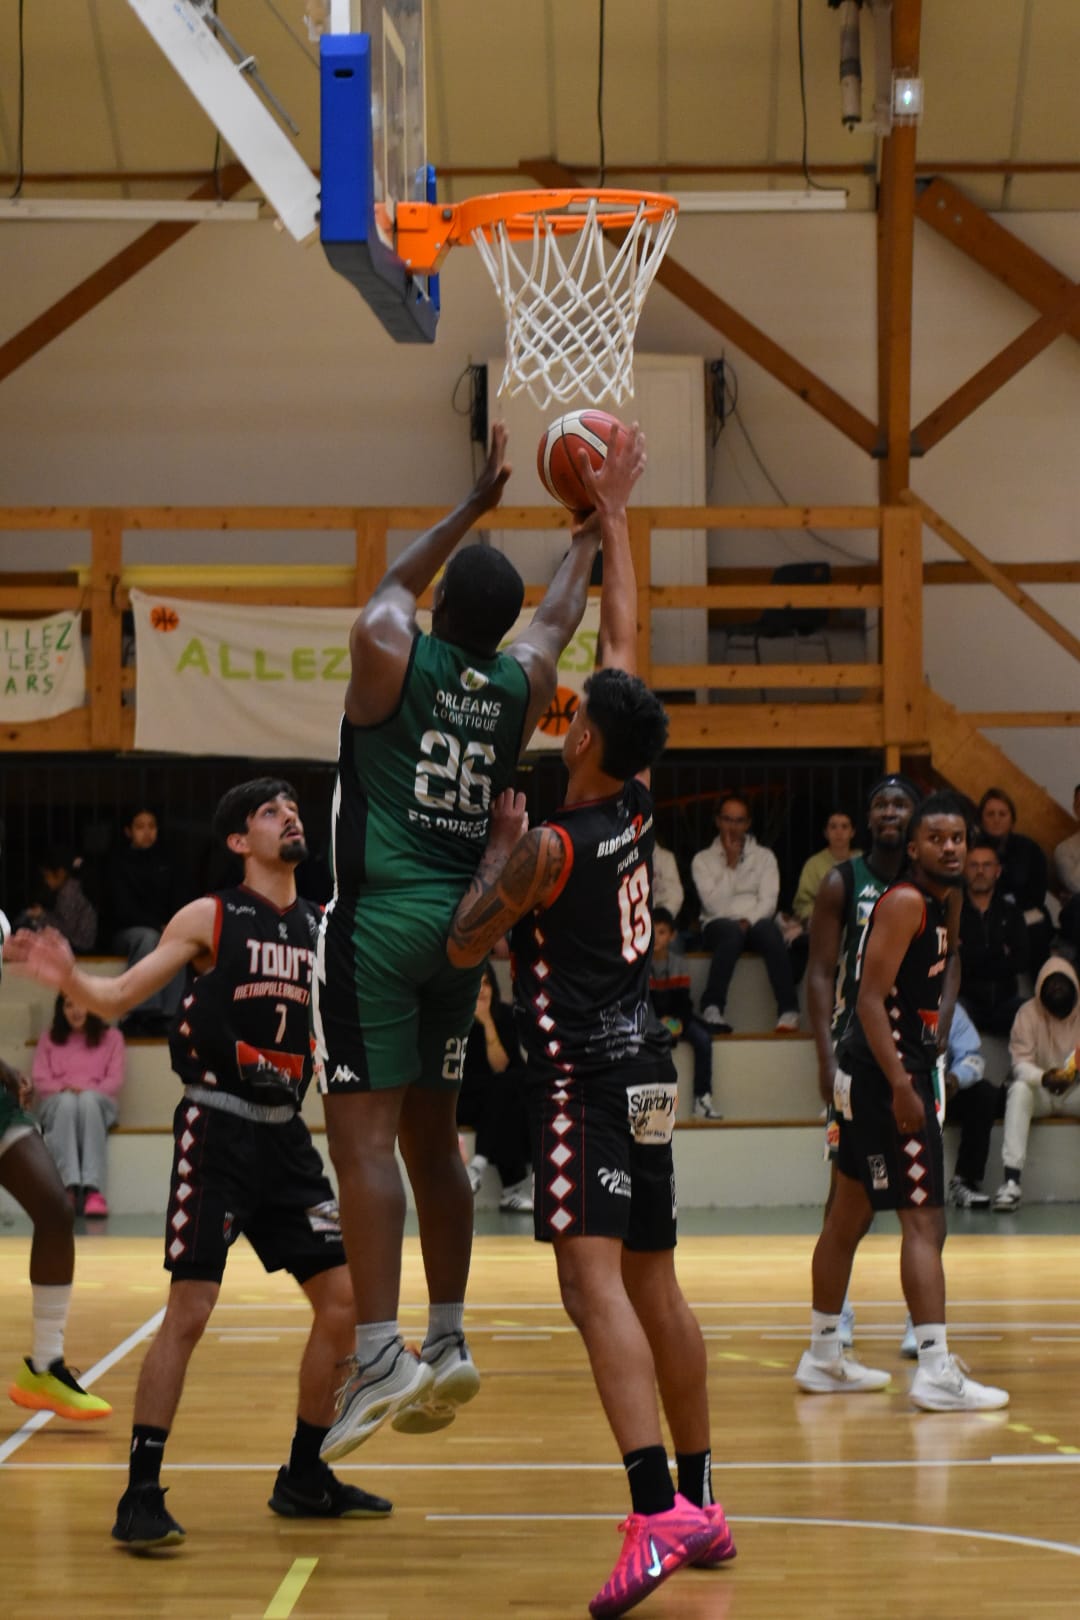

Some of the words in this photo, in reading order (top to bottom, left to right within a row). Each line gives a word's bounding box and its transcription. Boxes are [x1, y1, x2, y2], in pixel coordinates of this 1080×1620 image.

[9, 651, 50, 672] LES
[175, 636, 352, 681] ALLEZ
[433, 706, 498, 732] LOGISTIQUE
[414, 729, 496, 815] 26
[617, 861, 652, 964] 13
[275, 1003, 288, 1044] 7
